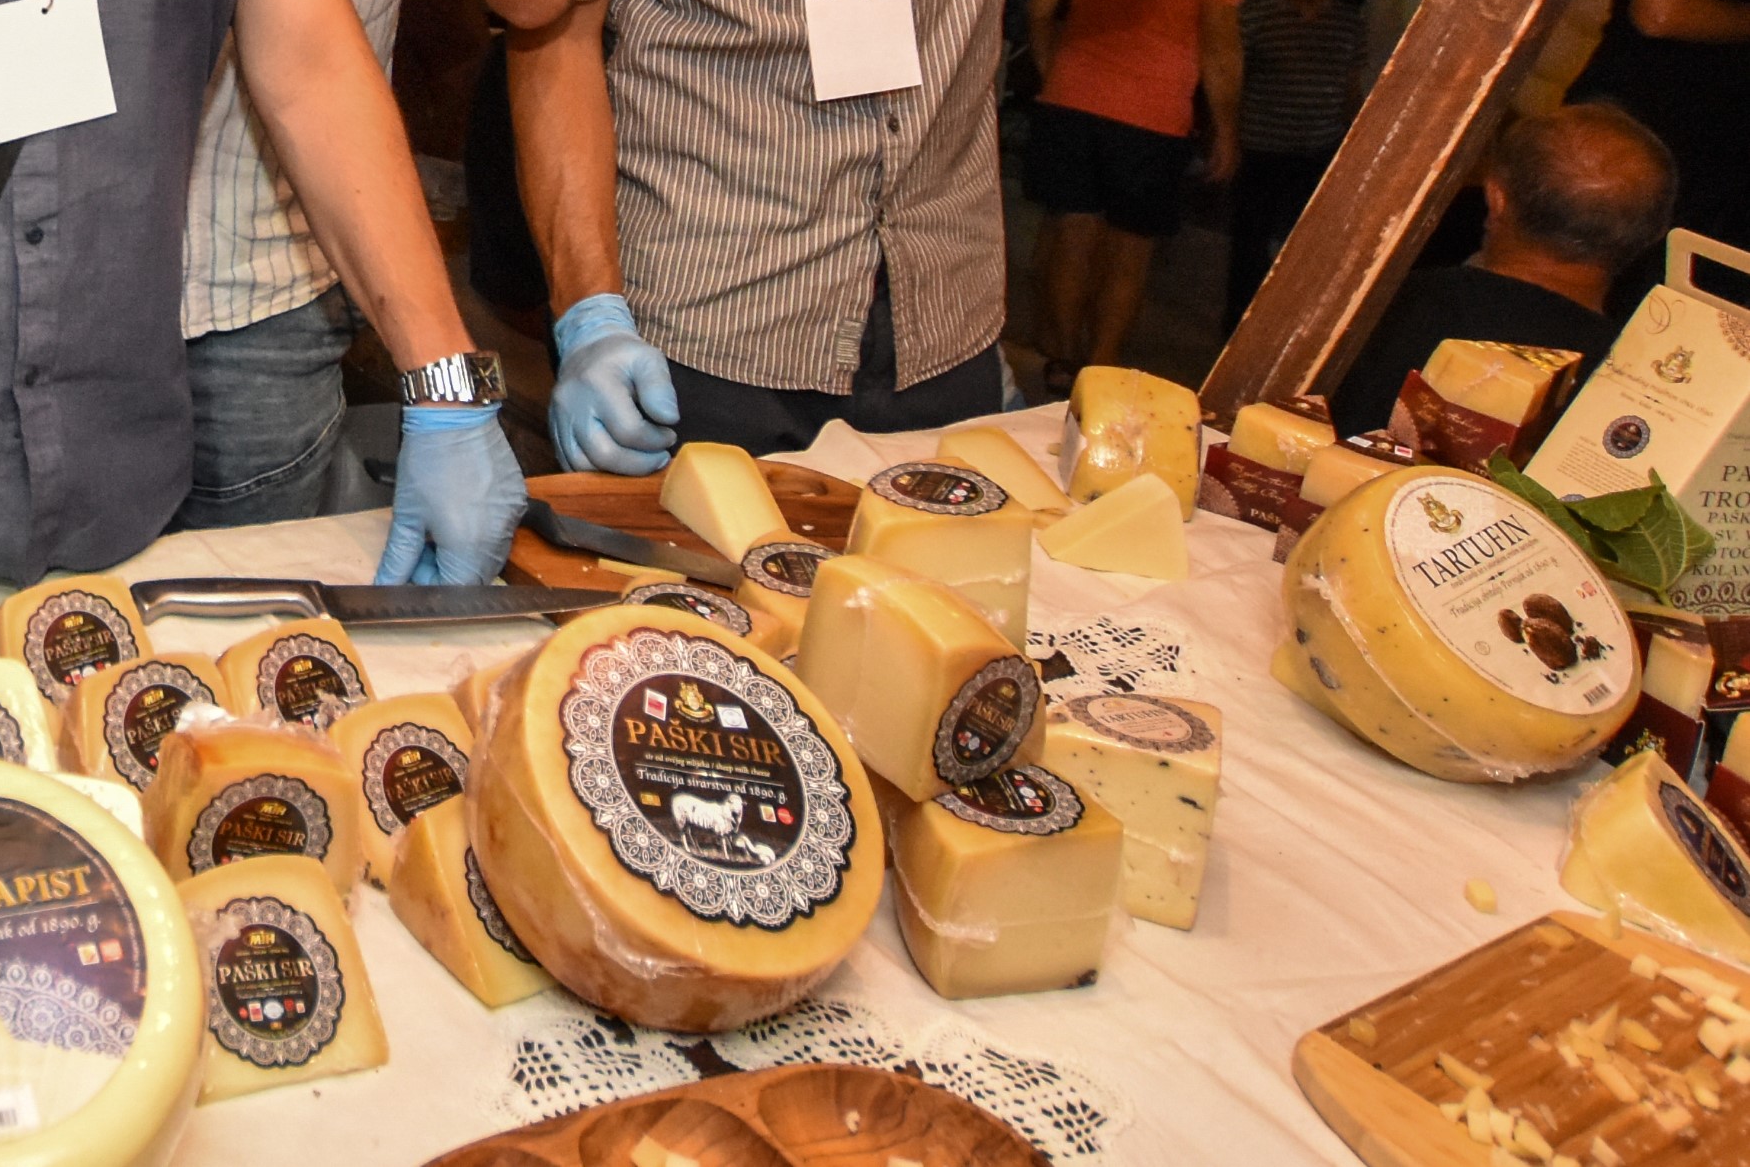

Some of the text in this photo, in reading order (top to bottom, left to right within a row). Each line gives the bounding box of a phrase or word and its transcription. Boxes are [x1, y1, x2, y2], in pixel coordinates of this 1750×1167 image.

[1413, 514, 1531, 588] TARTUFIN
[1100, 708, 1168, 724] TARTUFIN
[626, 719, 786, 767] PAŠKI SIR
[636, 768, 685, 789] Tradicija
[687, 777, 732, 792] sirarstva
[735, 782, 747, 795] od
[749, 787, 777, 800] 1890.
[220, 820, 273, 841] PAŠKI
[277, 829, 306, 848] SIR
[18, 918, 36, 938] od
[41, 916, 85, 936] 1890.
[218, 958, 315, 985] PAŠKI SIR
